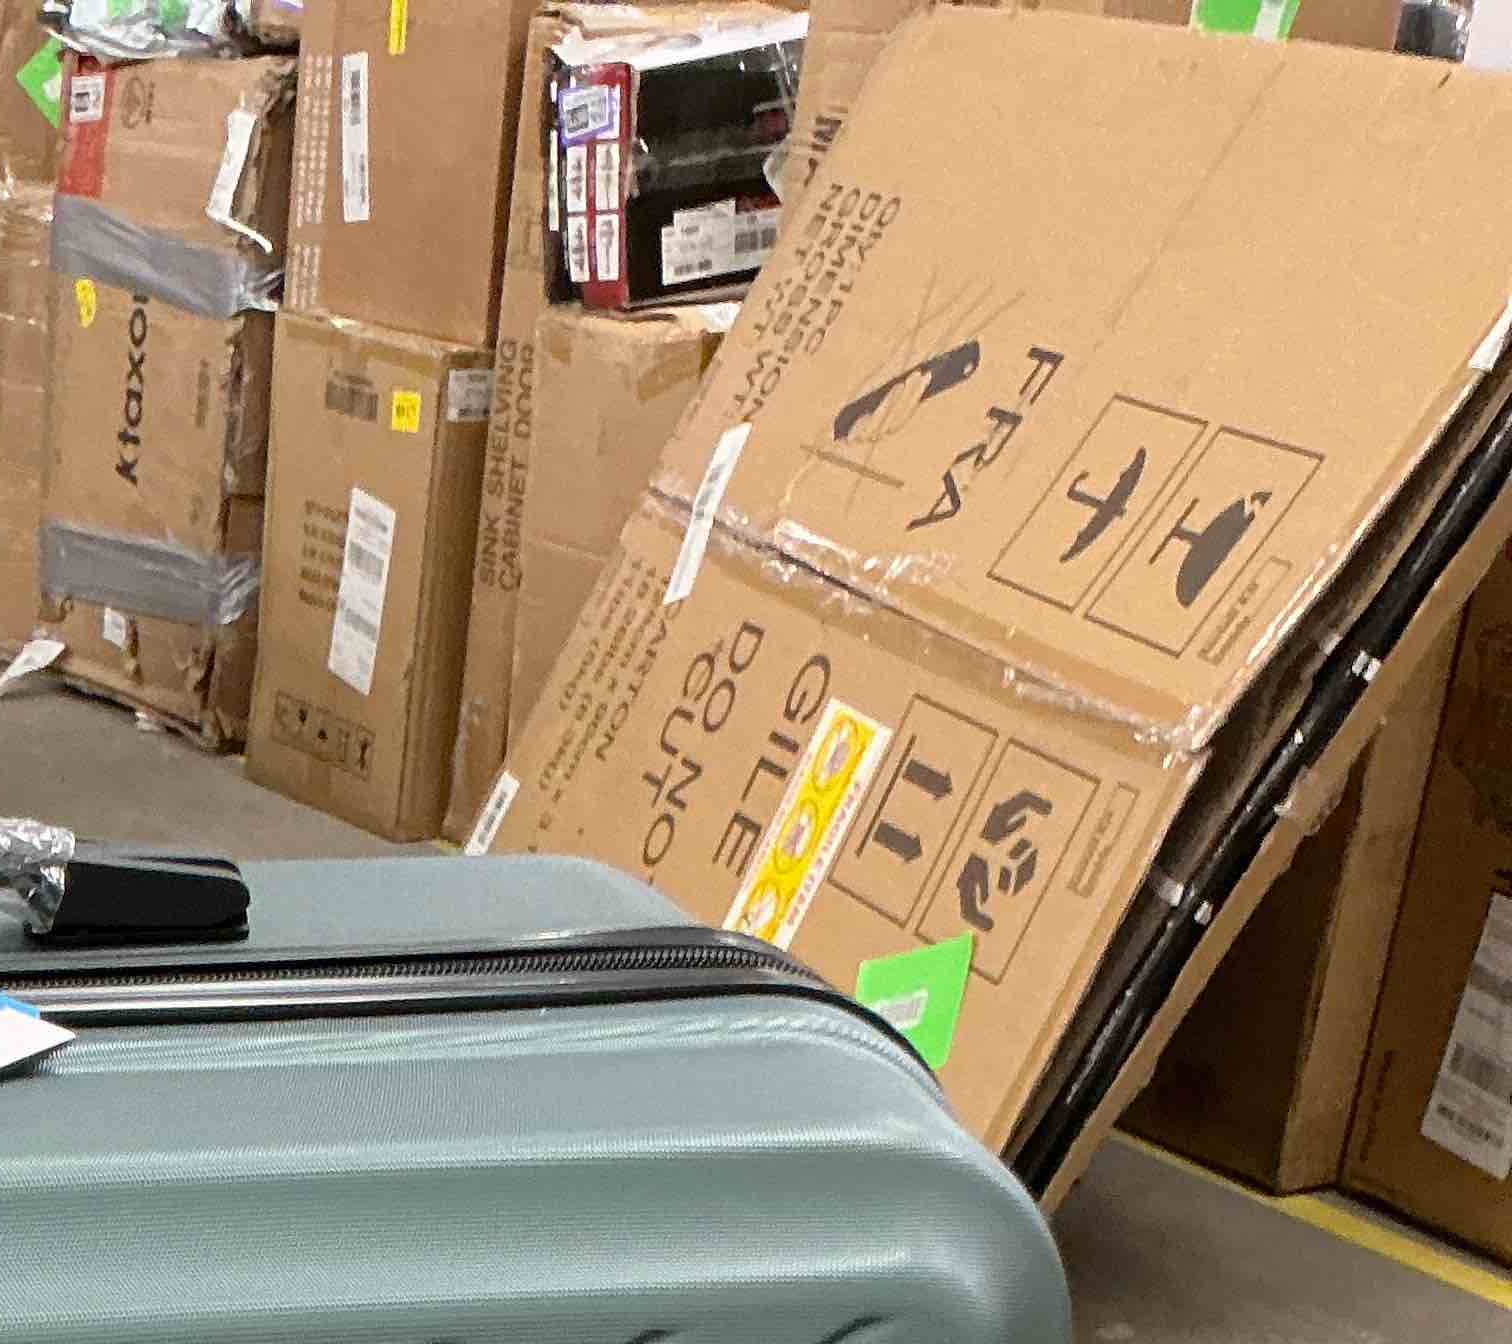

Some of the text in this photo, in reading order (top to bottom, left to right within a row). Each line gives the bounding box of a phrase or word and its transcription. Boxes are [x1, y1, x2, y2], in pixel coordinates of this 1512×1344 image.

[480, 338, 518, 586] SINK SHELVING
[498, 454, 527, 593] CABINET
[904, 346, 1065, 532] FRA
[642, 653, 716, 808] CUT
[643, 621, 765, 887] DO NO
[713, 654, 831, 878] GILE
